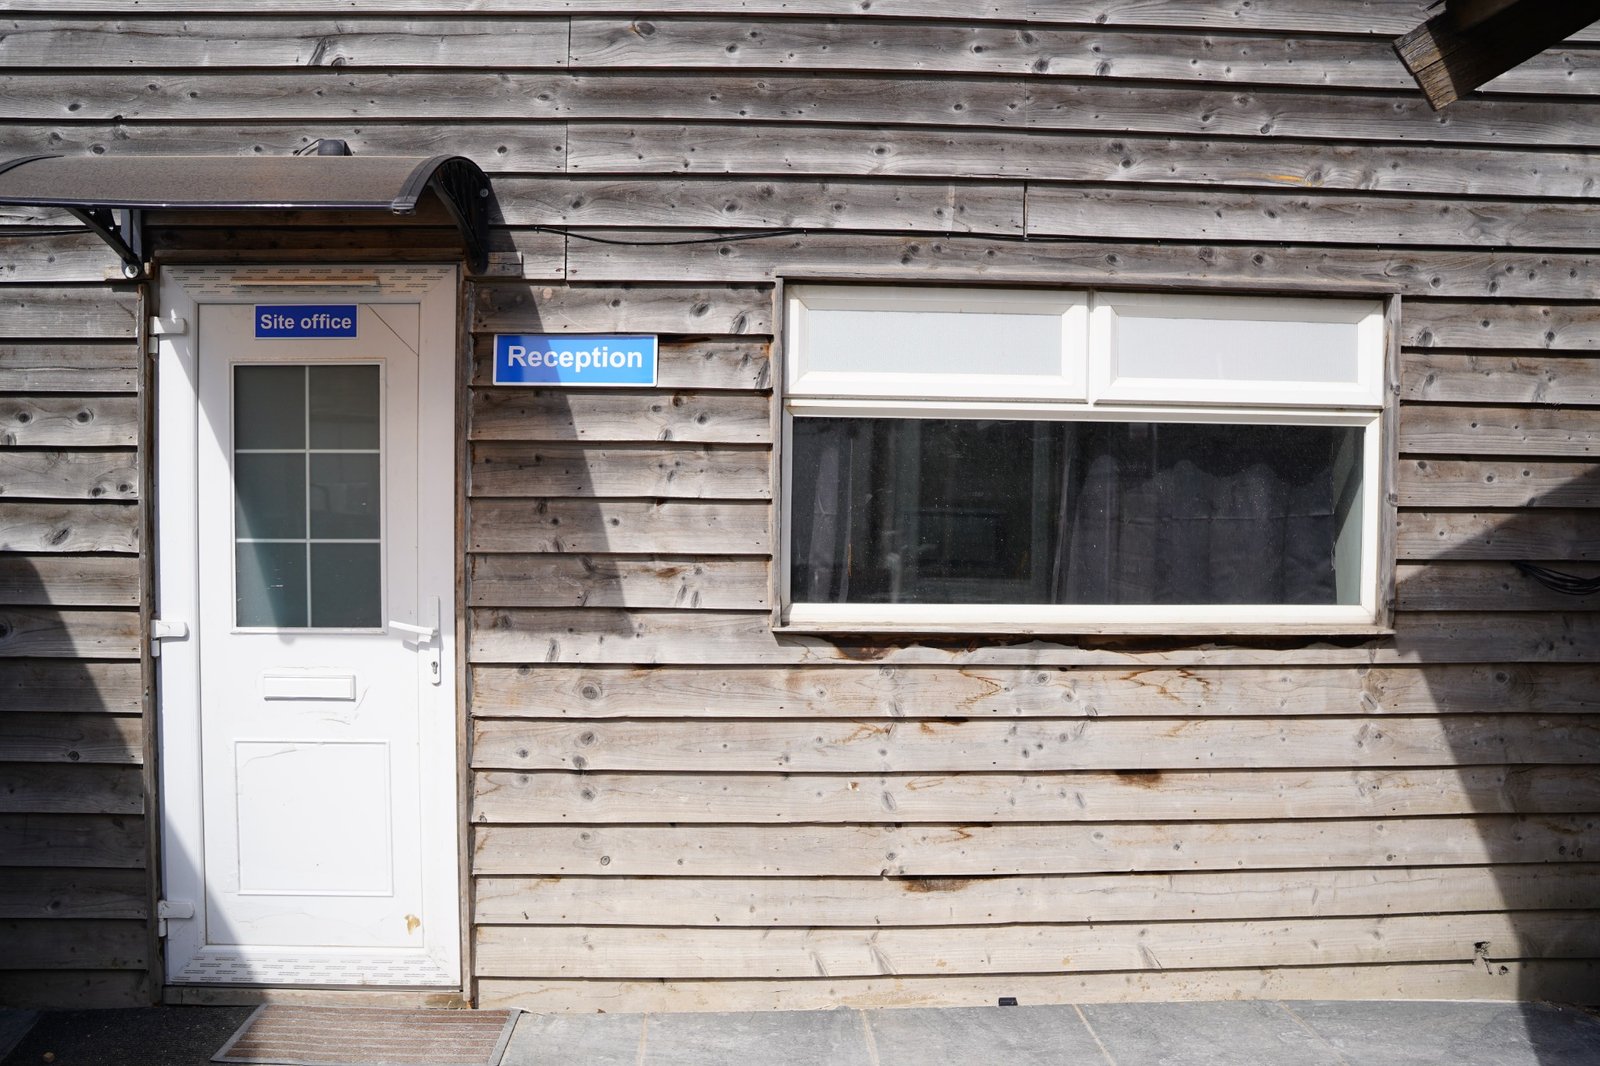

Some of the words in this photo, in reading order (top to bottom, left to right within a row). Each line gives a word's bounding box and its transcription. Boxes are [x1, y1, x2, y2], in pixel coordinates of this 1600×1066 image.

[261, 314, 295, 329] Site
[301, 313, 352, 329] office
[508, 345, 643, 373] Reception
